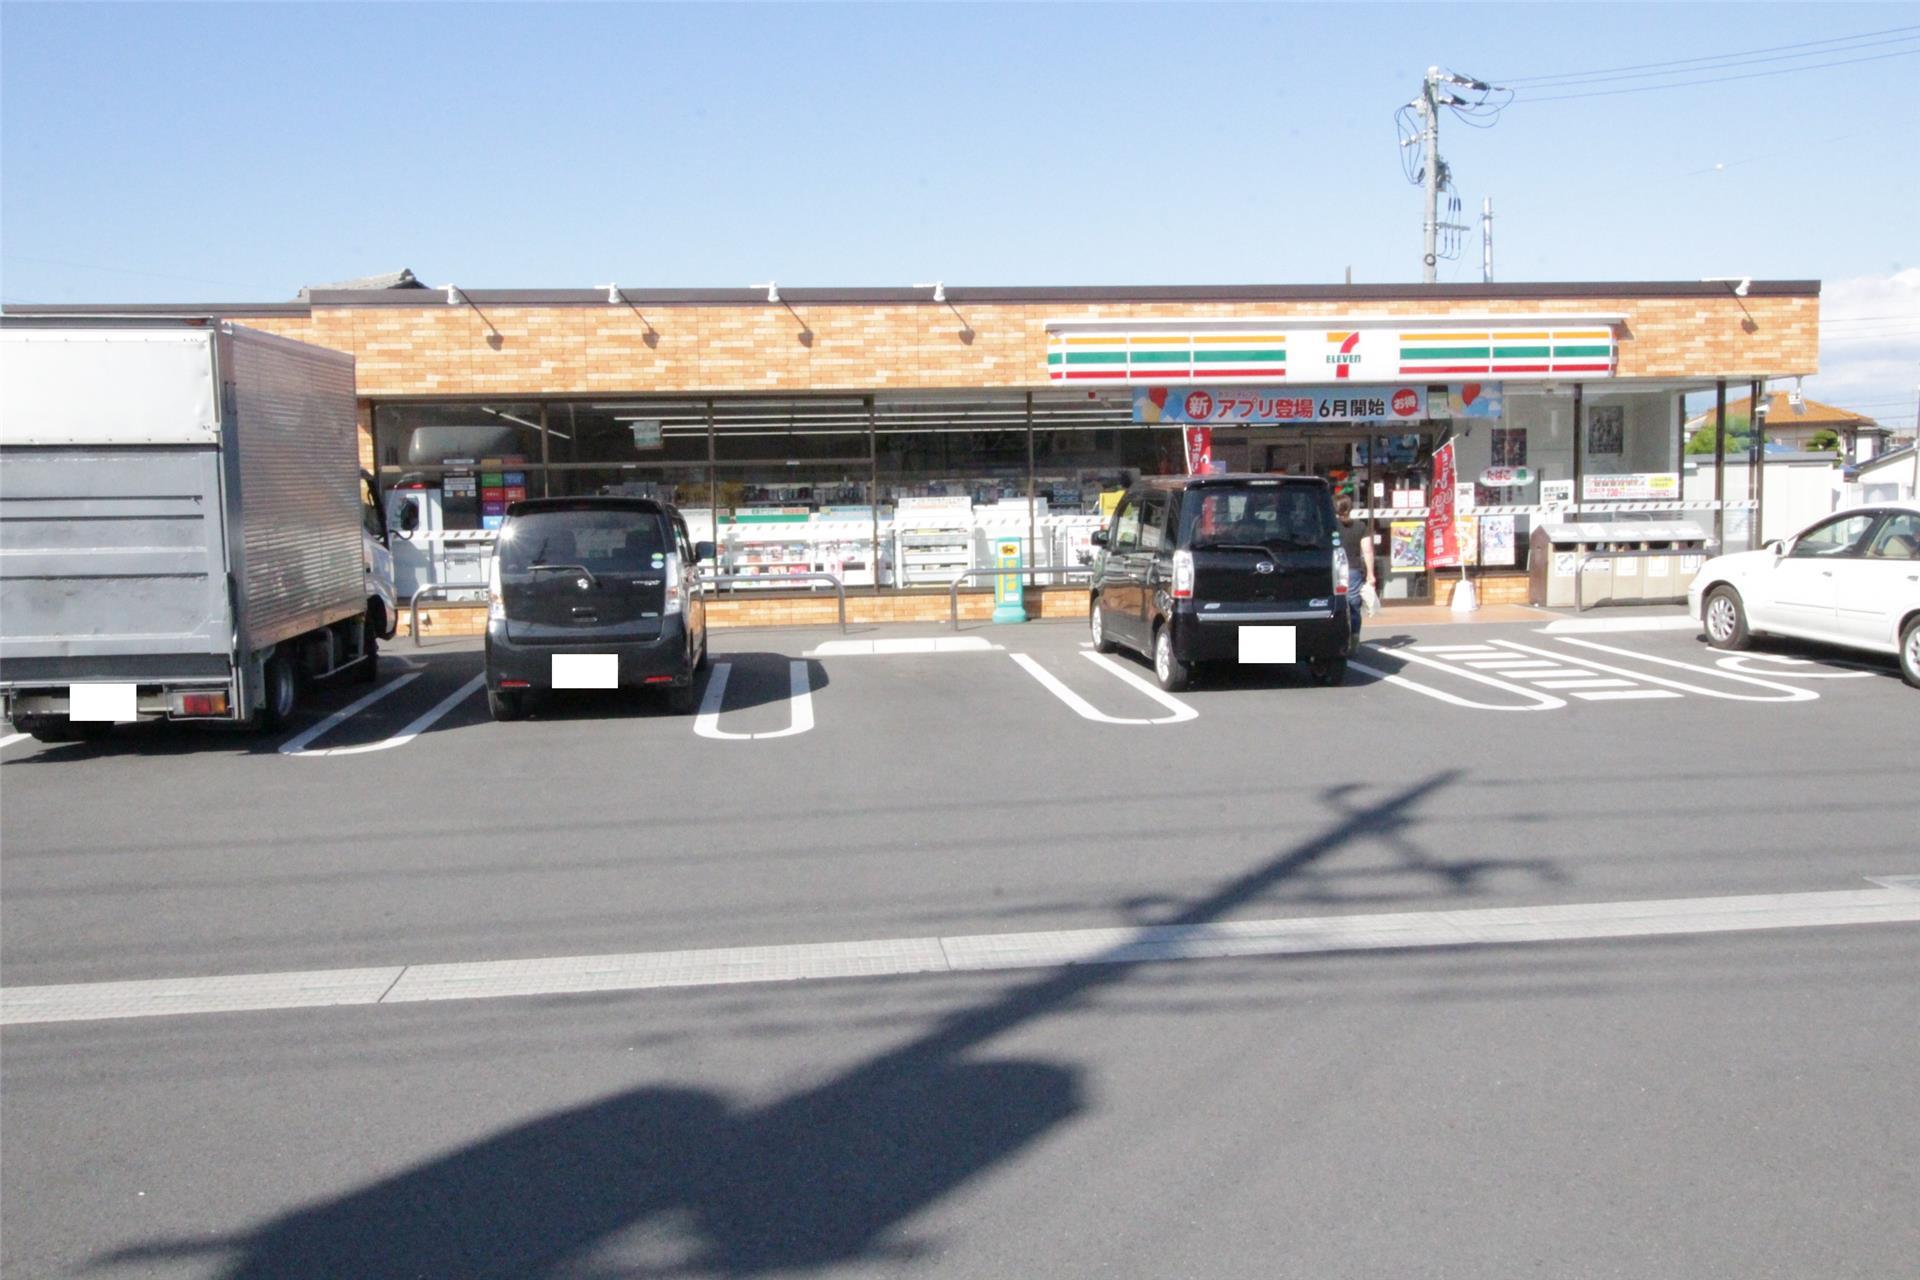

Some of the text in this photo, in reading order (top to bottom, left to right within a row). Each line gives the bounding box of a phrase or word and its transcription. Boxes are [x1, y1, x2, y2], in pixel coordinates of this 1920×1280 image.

[1327, 331, 1359, 378] 7
[1189, 396, 1416, 418] 新 アプリ登場 6月開始 お得
[1487, 470, 1512, 481] たばこ
